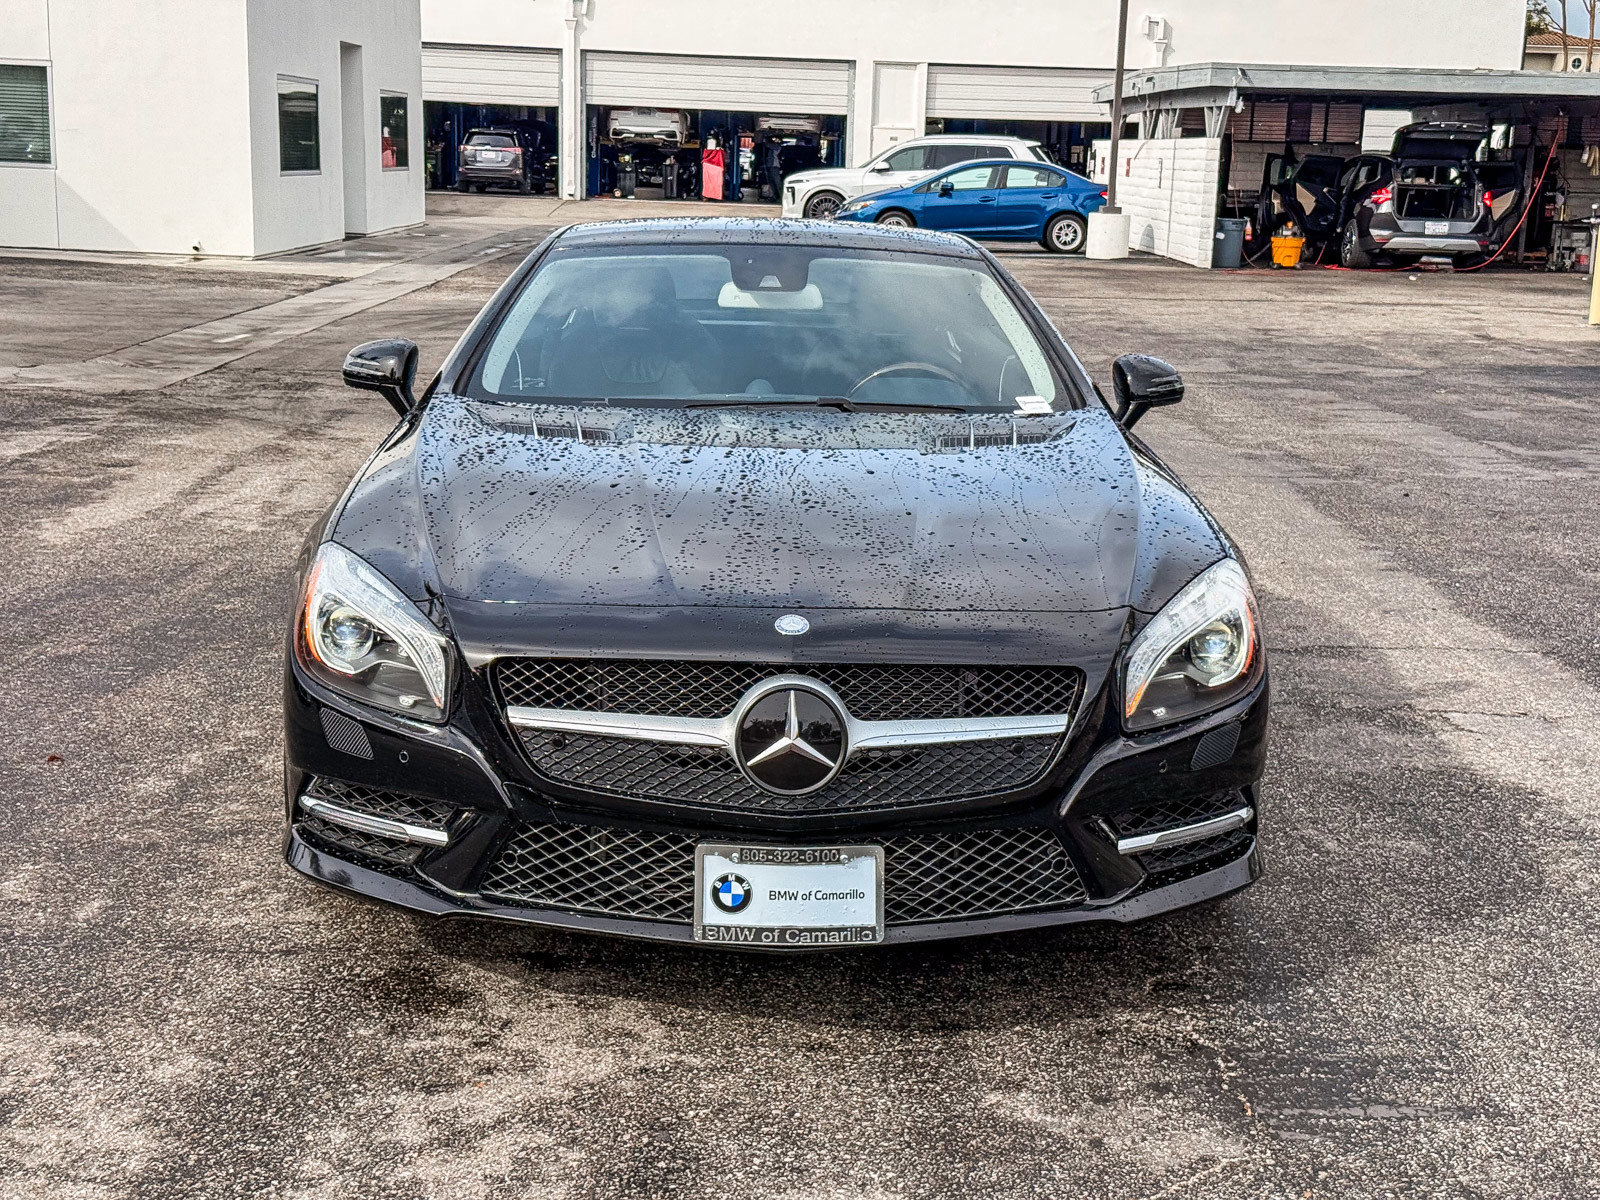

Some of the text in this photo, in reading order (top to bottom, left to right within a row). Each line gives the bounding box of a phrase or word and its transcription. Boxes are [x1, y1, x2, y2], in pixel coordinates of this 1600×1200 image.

[741, 850, 839, 862] 805-322-6100
[768, 888, 866, 901] BMW of Camarillo
[705, 926, 873, 944] BMW of Camarillo
